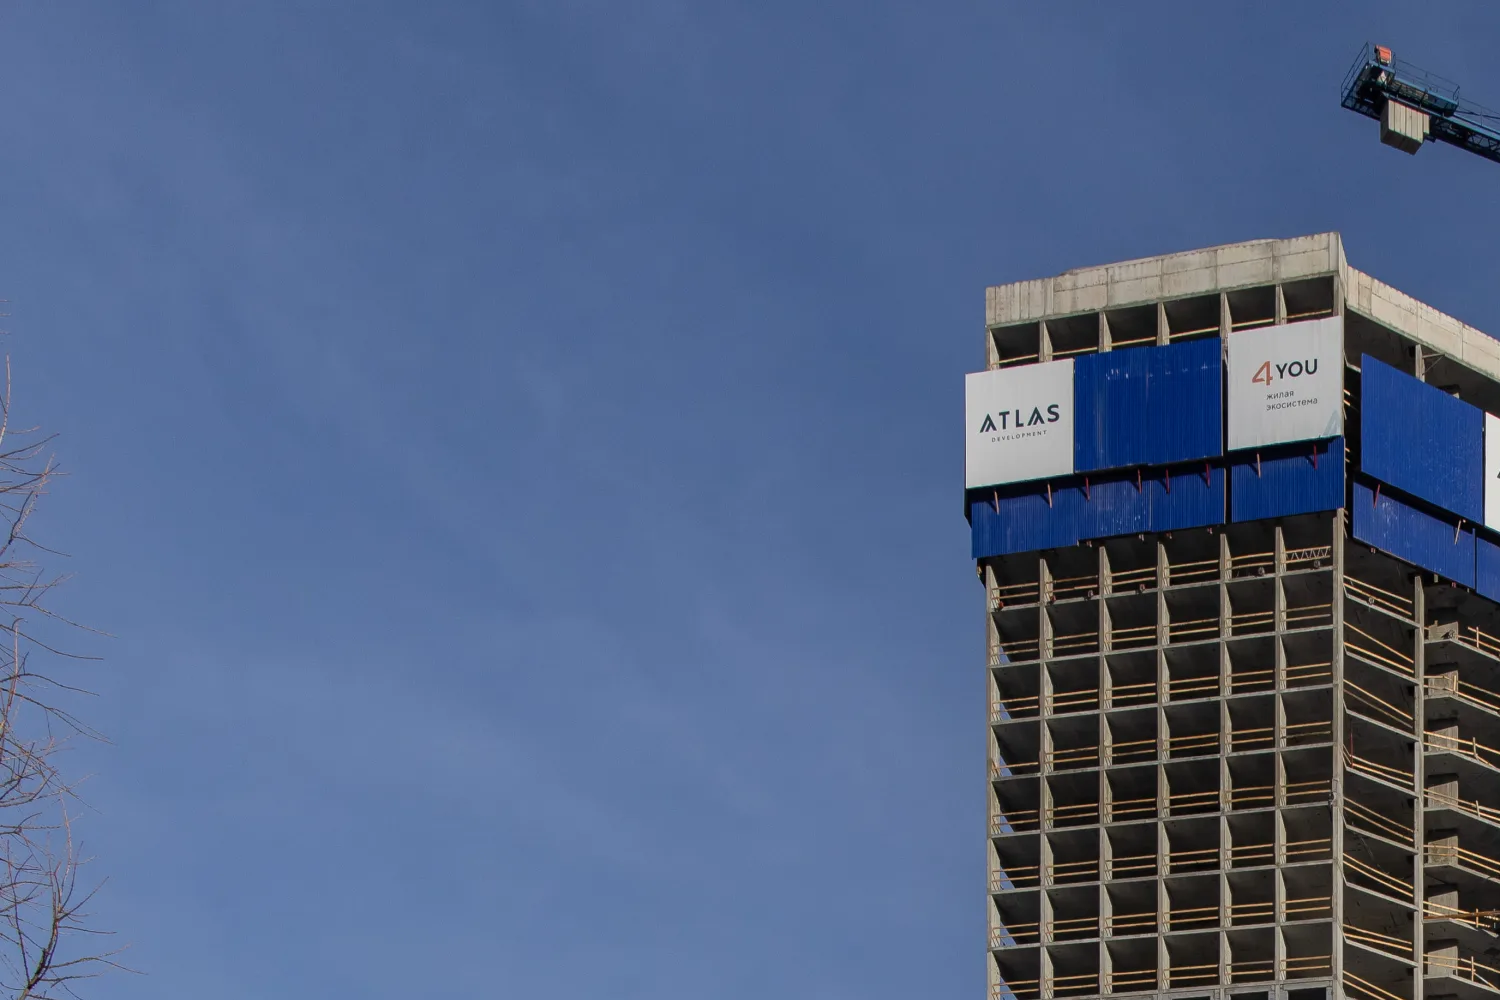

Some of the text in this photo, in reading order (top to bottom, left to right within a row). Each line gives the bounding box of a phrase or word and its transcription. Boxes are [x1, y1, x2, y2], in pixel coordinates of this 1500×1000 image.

[1266, 390, 1294, 400] жилая
[1266, 397, 1318, 411] экосистема
[979, 403, 1060, 433] ATLAS
[991, 430, 1048, 443] DEVELOPMENT
